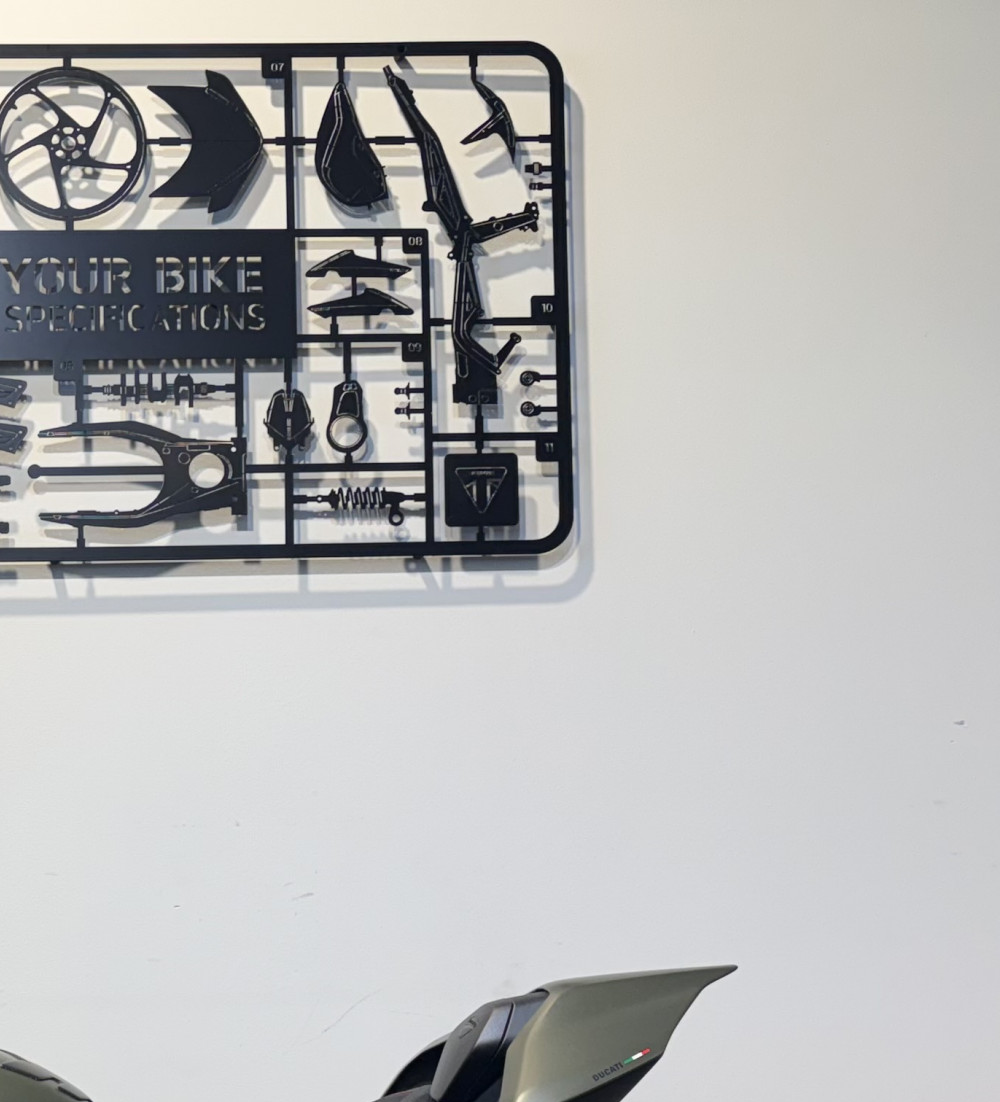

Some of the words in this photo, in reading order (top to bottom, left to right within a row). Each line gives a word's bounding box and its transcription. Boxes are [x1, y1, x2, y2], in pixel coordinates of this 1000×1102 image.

[270, 61, 285, 72] 07
[408, 236, 423, 246] 08
[155, 256, 264, 294] BIKE
[541, 302, 553, 313] 10
[4, 303, 266, 333] SPECIFICATIONS
[407, 342, 422, 353] 09
[544, 442, 554, 453] 11
[592, 1061, 624, 1082] DUCATI
